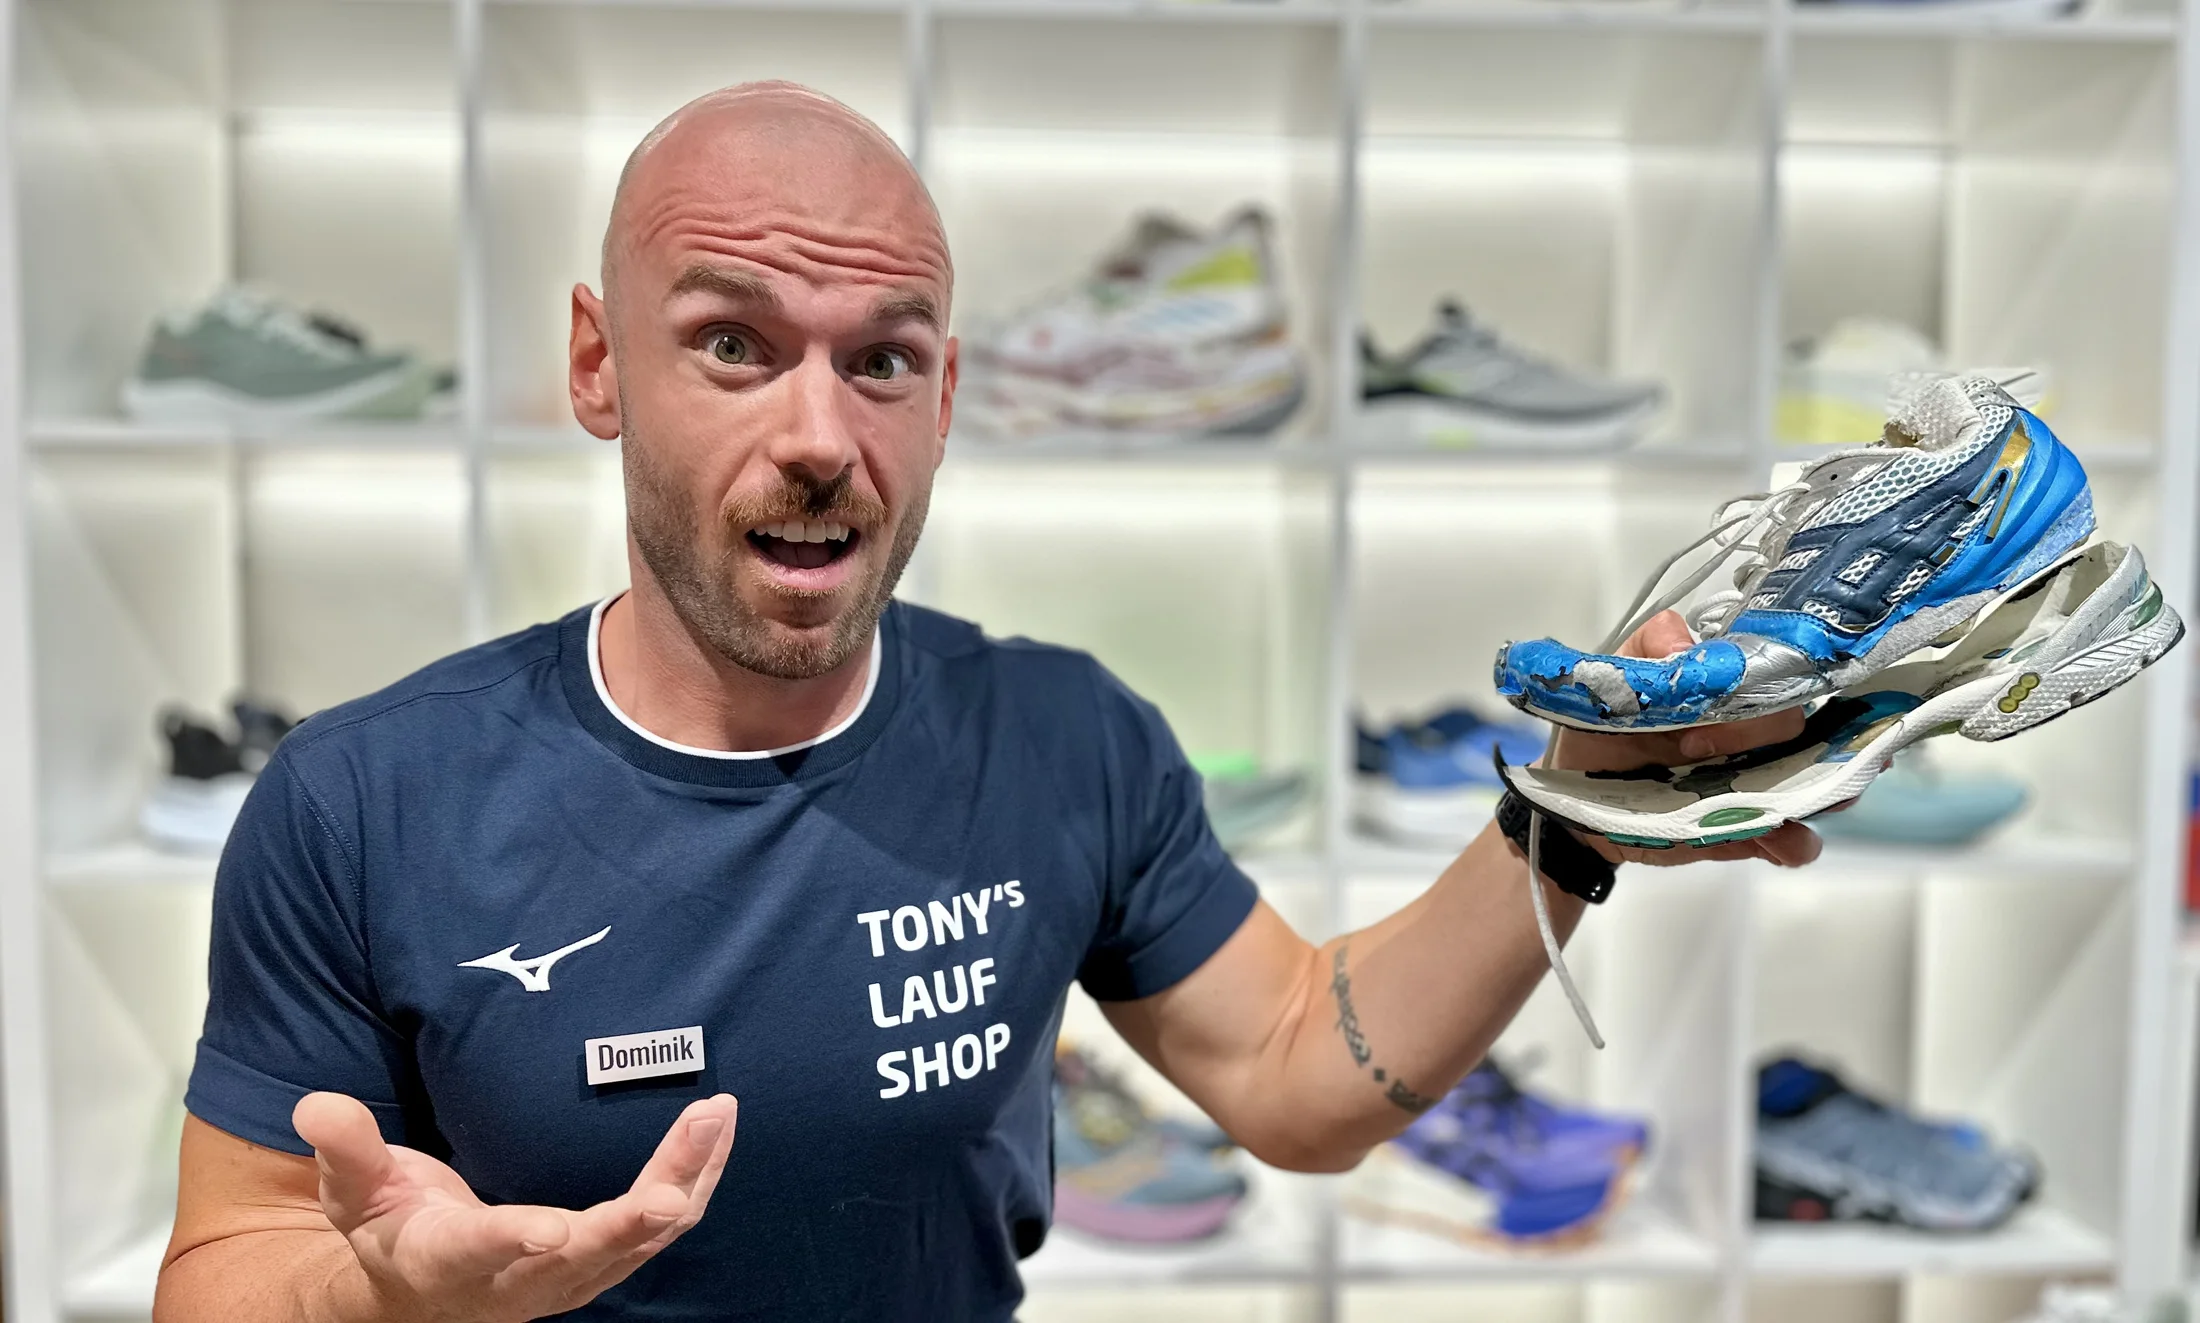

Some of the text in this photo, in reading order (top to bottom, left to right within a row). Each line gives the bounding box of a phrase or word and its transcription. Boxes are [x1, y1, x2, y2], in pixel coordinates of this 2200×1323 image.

[869, 958, 996, 1027] LAUF
[598, 1034, 695, 1072] Dominik
[877, 1023, 1010, 1098] SHOP
